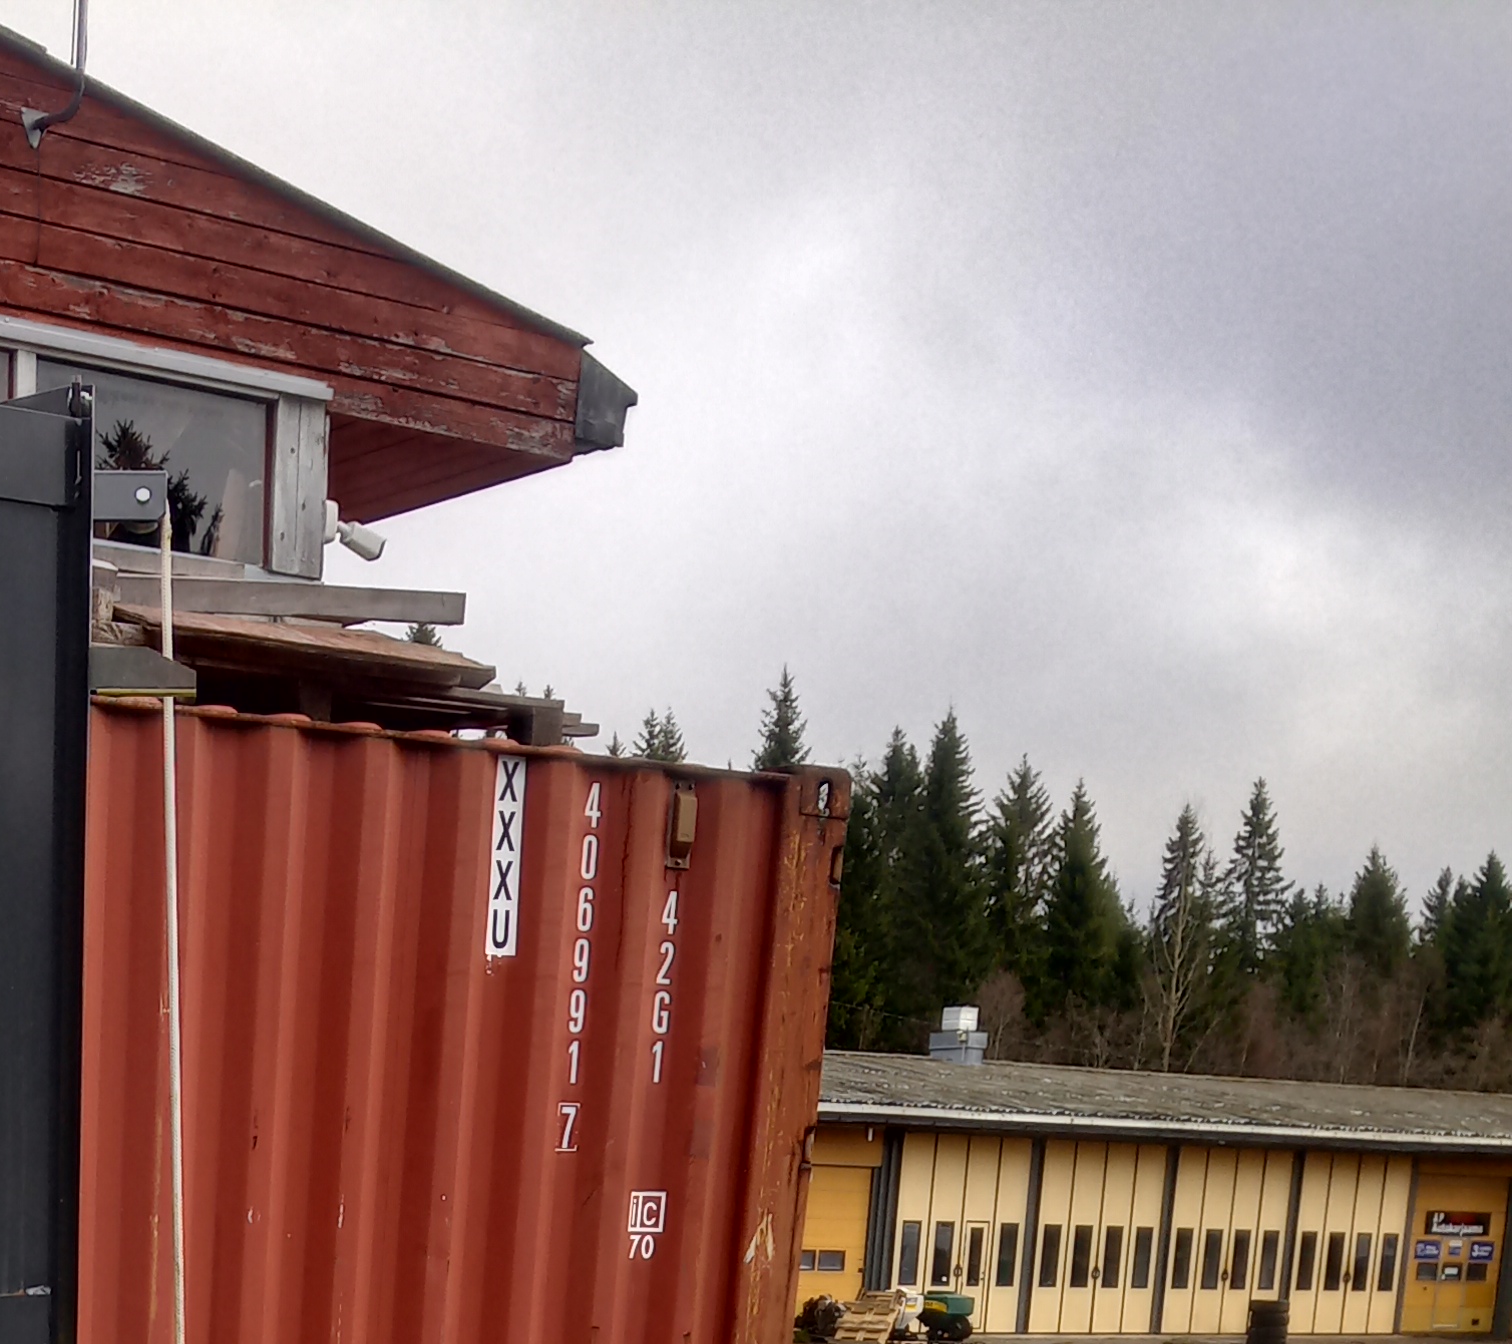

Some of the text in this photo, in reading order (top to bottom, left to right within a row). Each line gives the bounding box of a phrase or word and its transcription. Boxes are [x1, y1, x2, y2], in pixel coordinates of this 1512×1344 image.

[491, 760, 520, 949] XXXU
[558, 782, 601, 1151] 406991 7
[651, 891, 678, 1083] 42G1
[628, 1233, 655, 1260] 70
